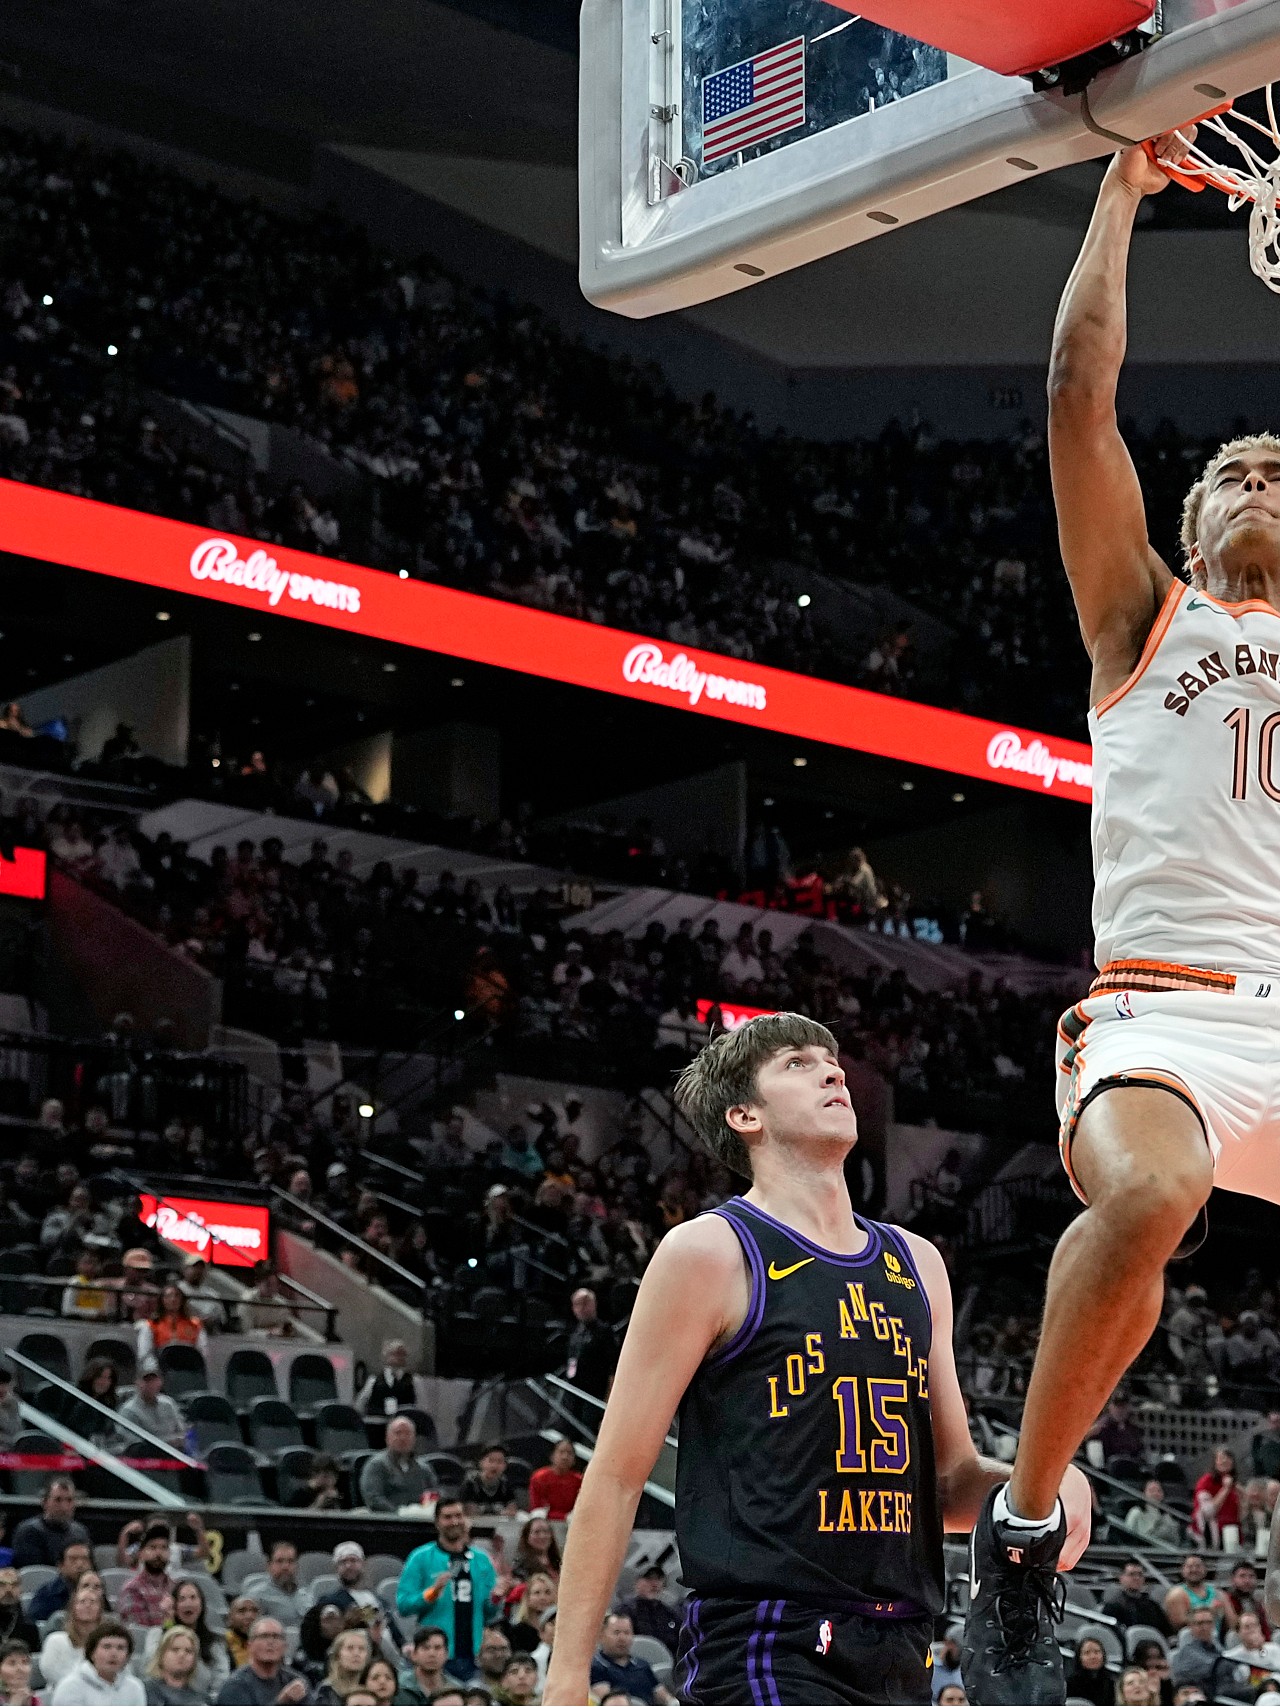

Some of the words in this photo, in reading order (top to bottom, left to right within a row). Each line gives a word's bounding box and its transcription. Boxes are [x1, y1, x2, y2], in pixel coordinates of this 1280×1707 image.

[190, 538, 290, 606] Bally
[288, 573, 361, 613] SPORTS
[623, 643, 707, 705] Bally
[705, 674, 767, 711] SPORTS
[1164, 651, 1231, 717] SAN
[987, 730, 1060, 788] Bally
[884, 1269, 916, 1290] bibigo
[766, 1332, 826, 1418] LOS
[837, 1282, 929, 1399] ANGELE
[832, 1376, 911, 1475] 15
[817, 1489, 912, 1534] LAKERS
